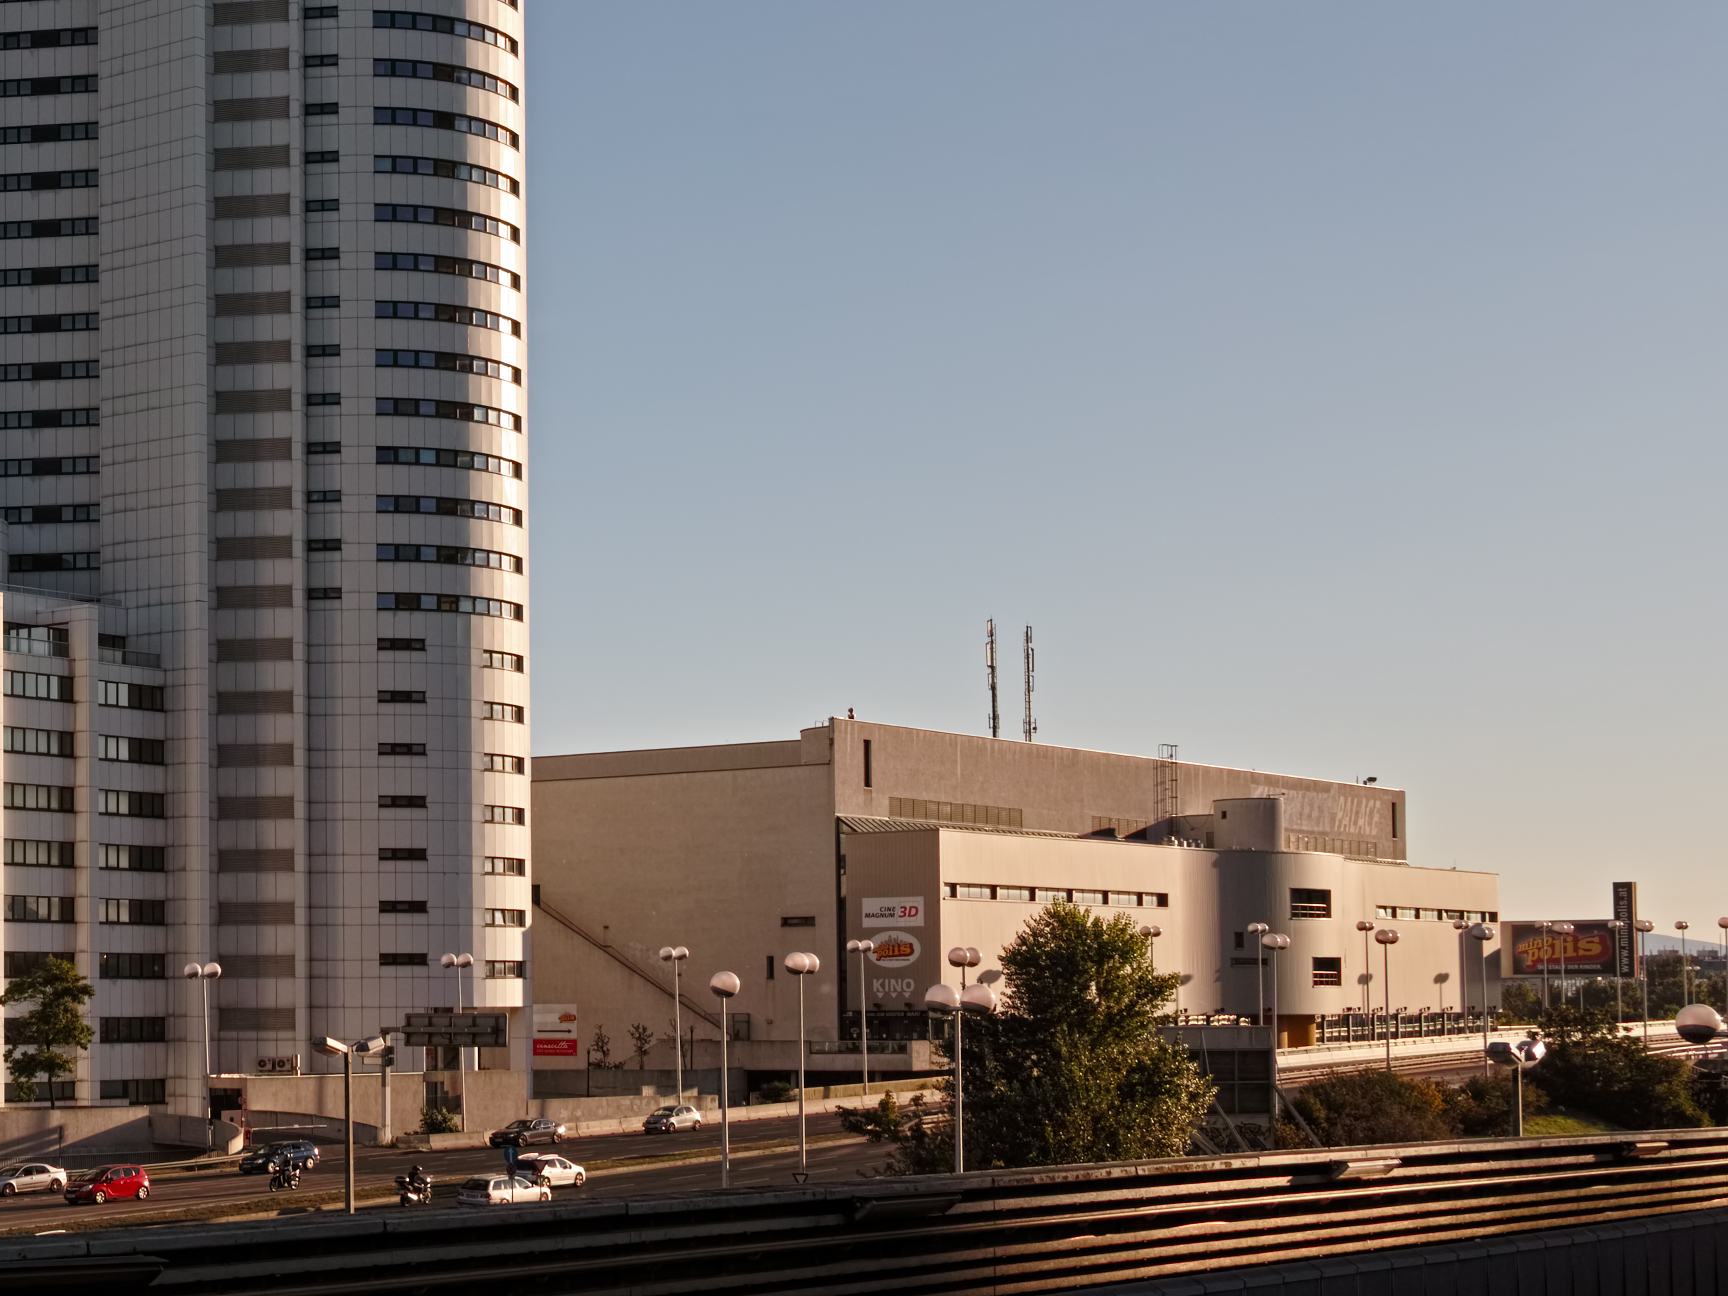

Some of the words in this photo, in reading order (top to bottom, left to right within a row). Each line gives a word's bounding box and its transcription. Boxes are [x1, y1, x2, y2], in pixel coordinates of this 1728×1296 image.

[1334, 796, 1381, 835] PALACE
[898, 905, 919, 918] 3D
[1525, 935, 1602, 966] polis
[872, 978, 915, 992] KINO
